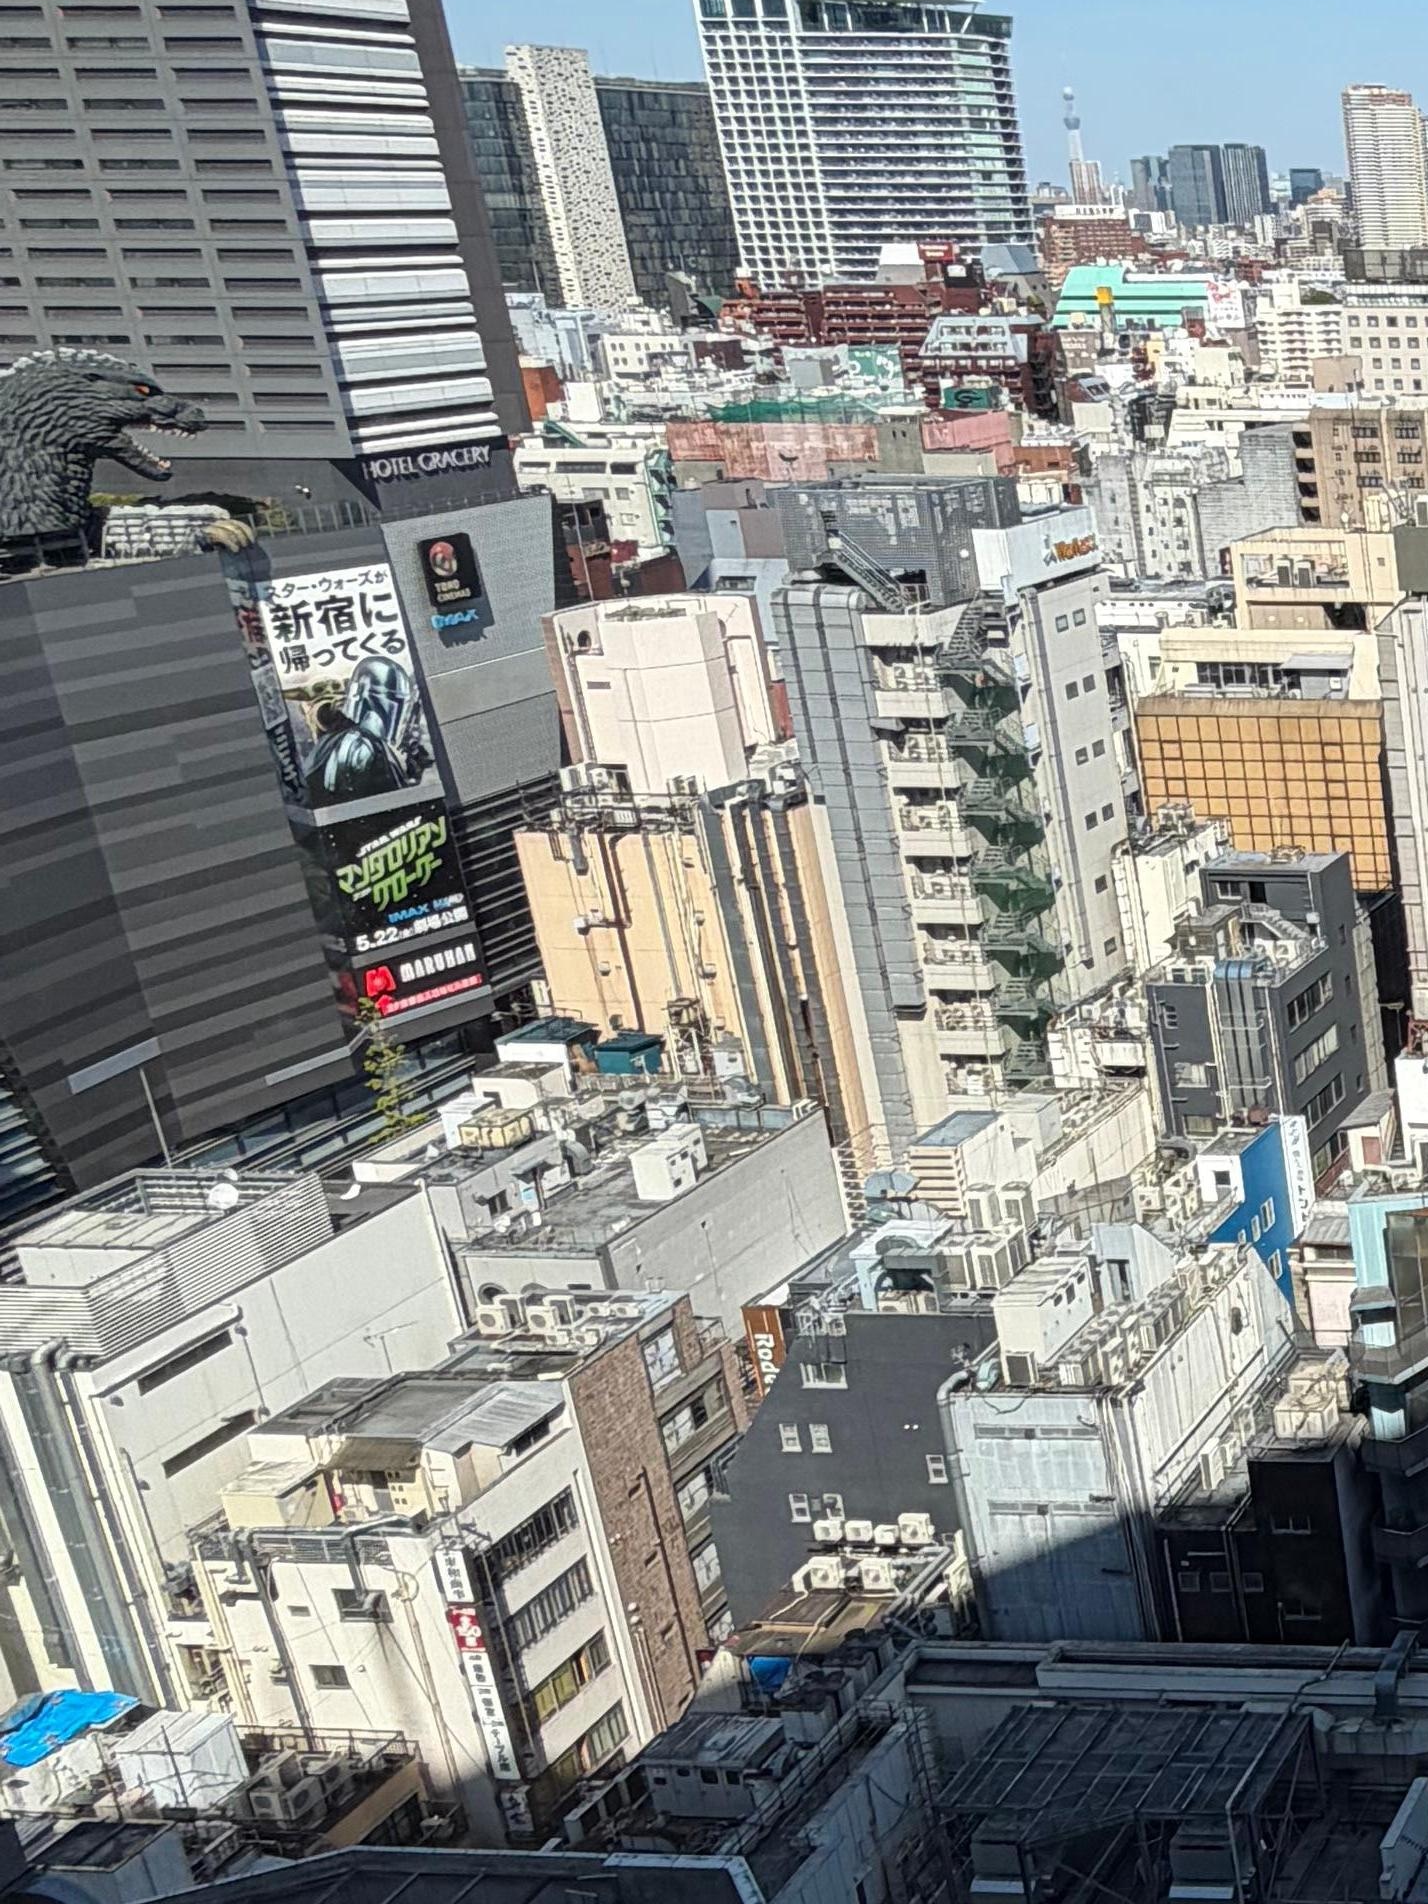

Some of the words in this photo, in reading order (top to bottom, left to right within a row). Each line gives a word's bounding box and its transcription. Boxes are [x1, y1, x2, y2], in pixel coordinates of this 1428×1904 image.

[361, 456, 417, 480] HOTEL
[418, 444, 491, 471] GRACERY
[269, 592, 399, 643] 新宿に
[278, 628, 407, 674] 帰ってくる
[399, 943, 477, 983] MARUHAN
